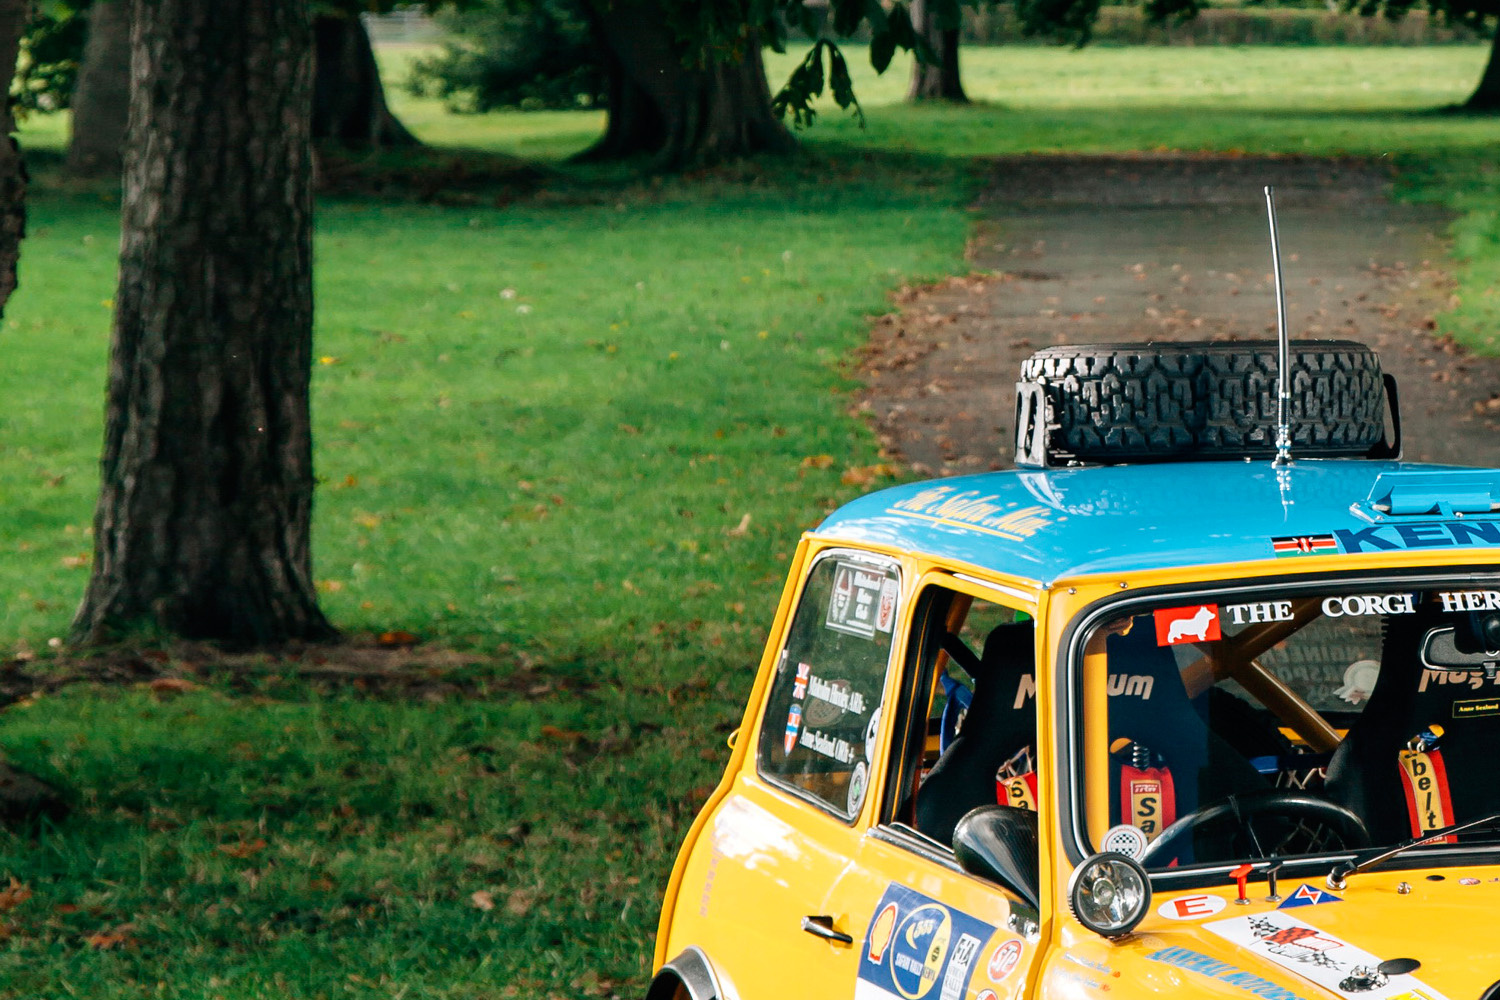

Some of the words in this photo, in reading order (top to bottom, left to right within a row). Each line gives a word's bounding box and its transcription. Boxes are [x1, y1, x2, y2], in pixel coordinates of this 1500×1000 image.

[1226, 601, 1295, 625] THE
[1322, 593, 1417, 618] CORGI
[1173, 896, 1213, 918] E
[952, 938, 975, 967] FIA
[990, 943, 1018, 975] STP
